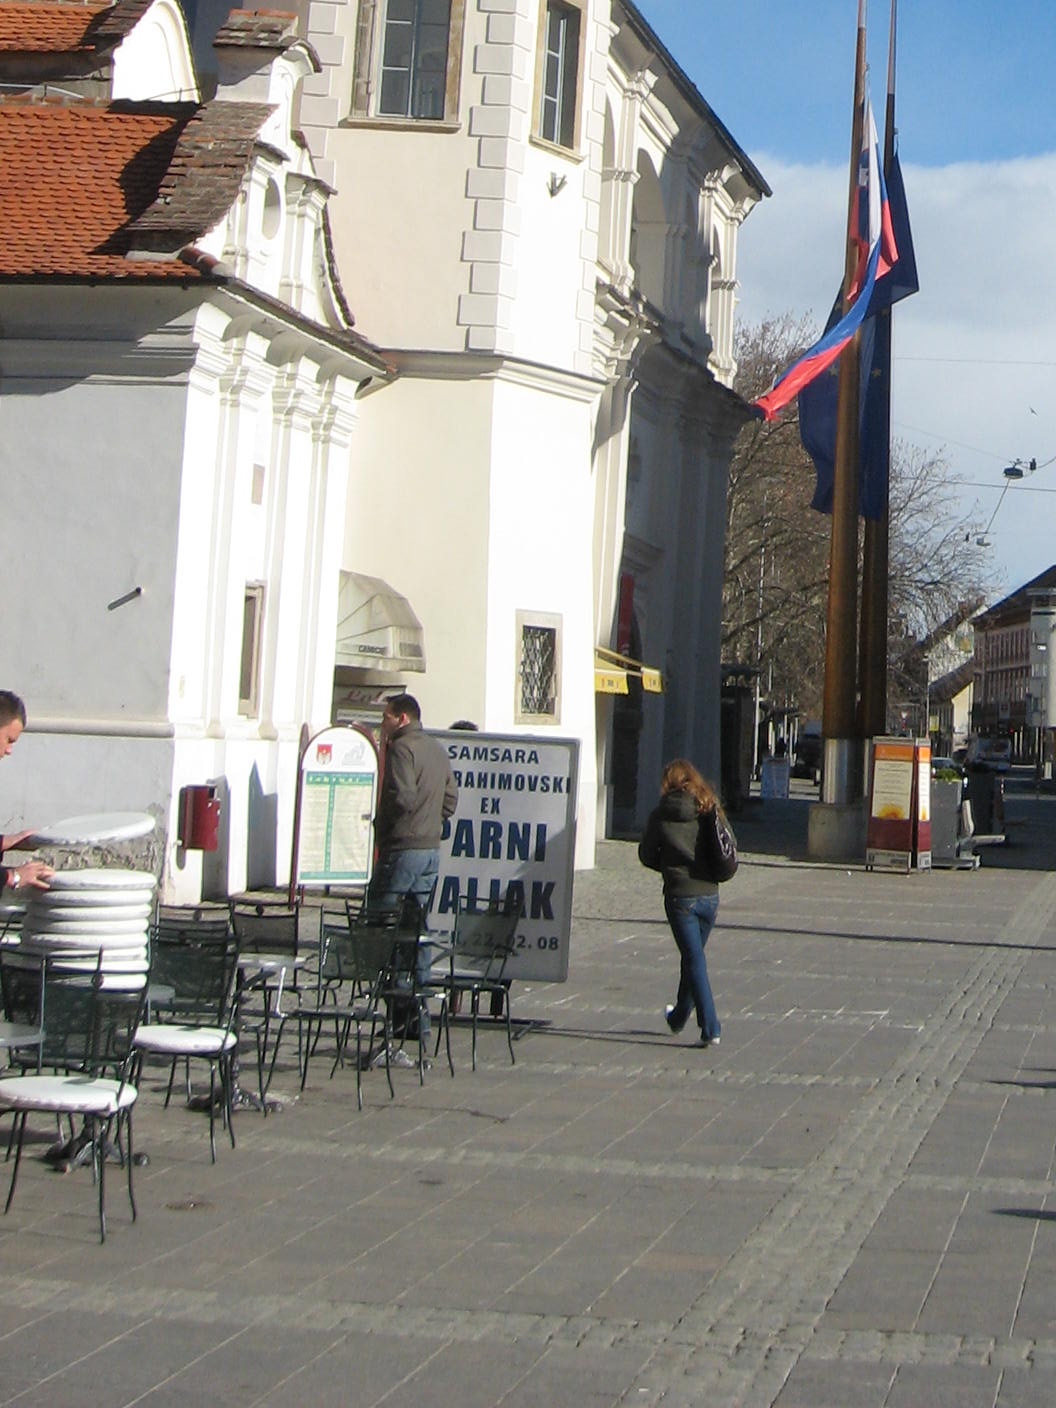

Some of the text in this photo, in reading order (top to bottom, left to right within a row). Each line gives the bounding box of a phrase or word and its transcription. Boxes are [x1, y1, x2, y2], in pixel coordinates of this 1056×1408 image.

[448, 745, 539, 764] SAMSARA
[452, 771, 571, 794] RAHIMOVSKI
[480, 797, 500, 815] EX
[537, 937, 559, 950] 08
